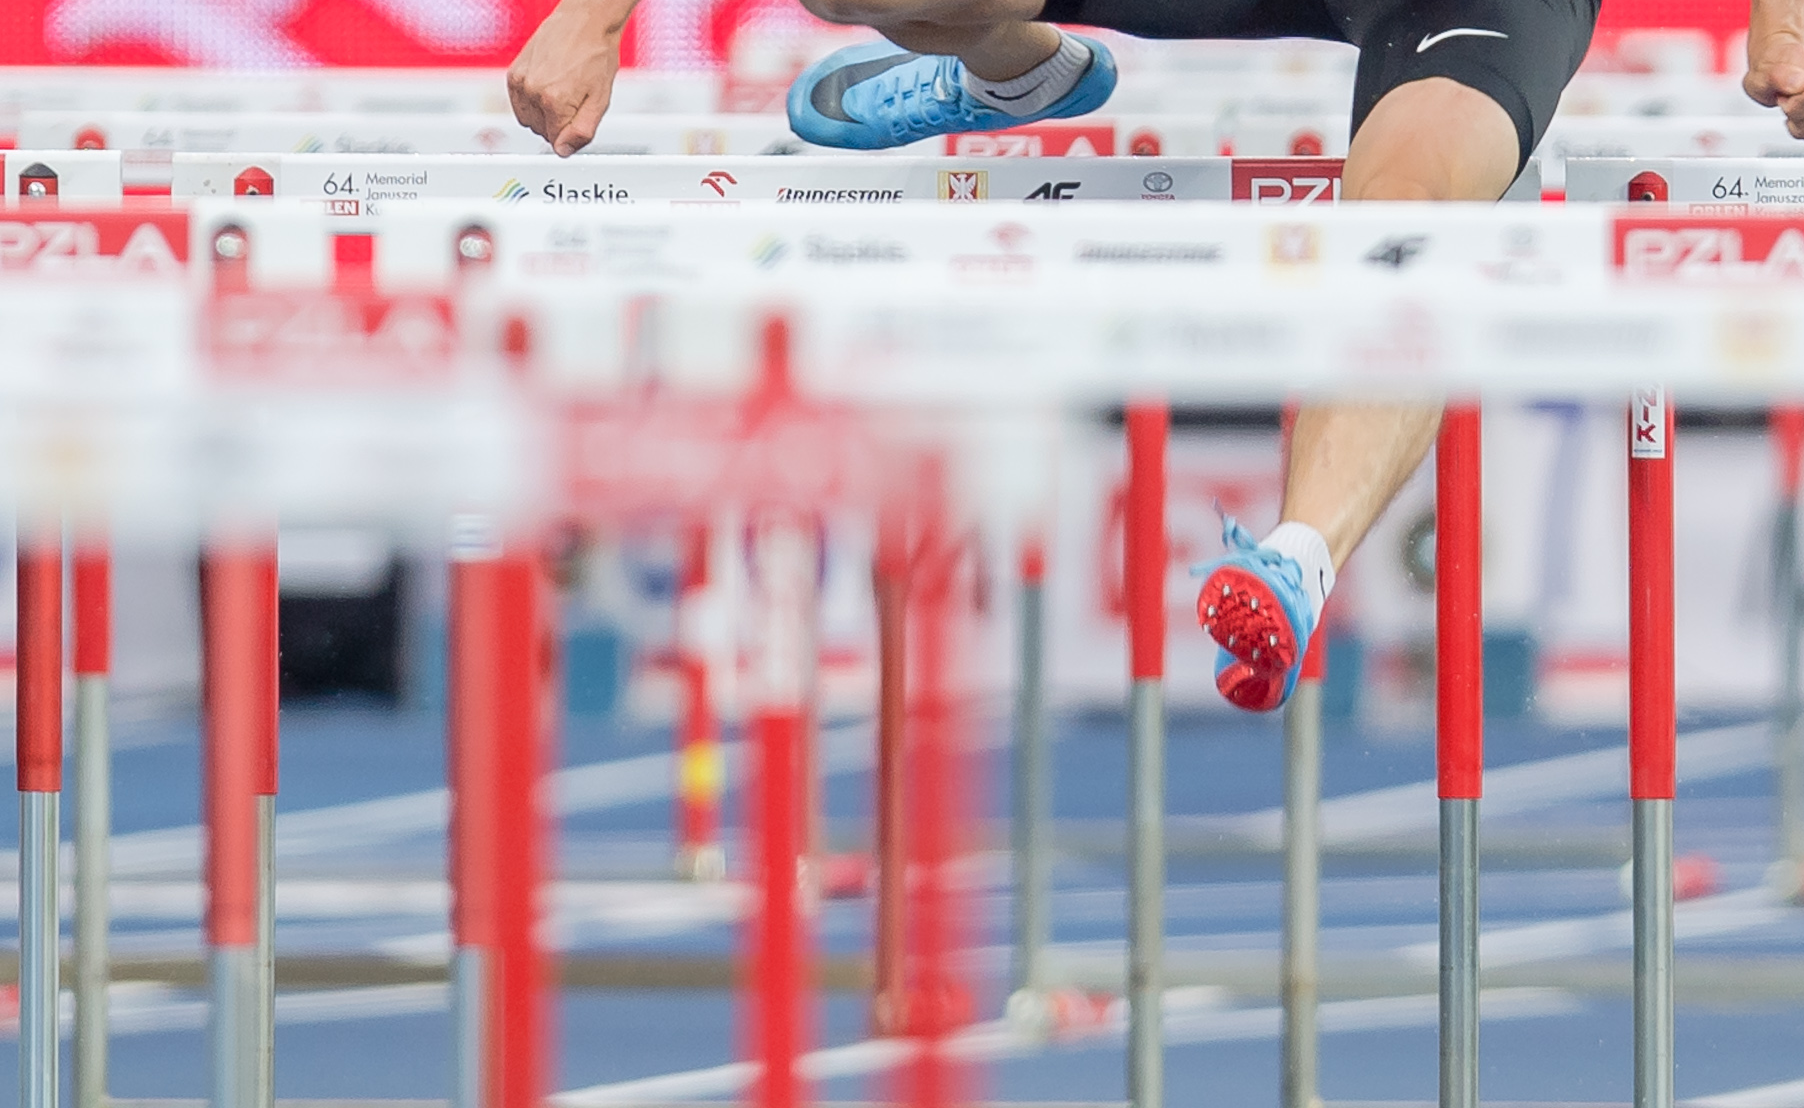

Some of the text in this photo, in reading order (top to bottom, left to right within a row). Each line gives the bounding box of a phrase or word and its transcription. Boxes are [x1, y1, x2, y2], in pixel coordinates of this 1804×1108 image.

[323, 172, 360, 195] 64.
[1712, 176, 1749, 199] 64.
[364, 188, 418, 201] Janusza
[776, 187, 904, 204] BRIDGESTONE
